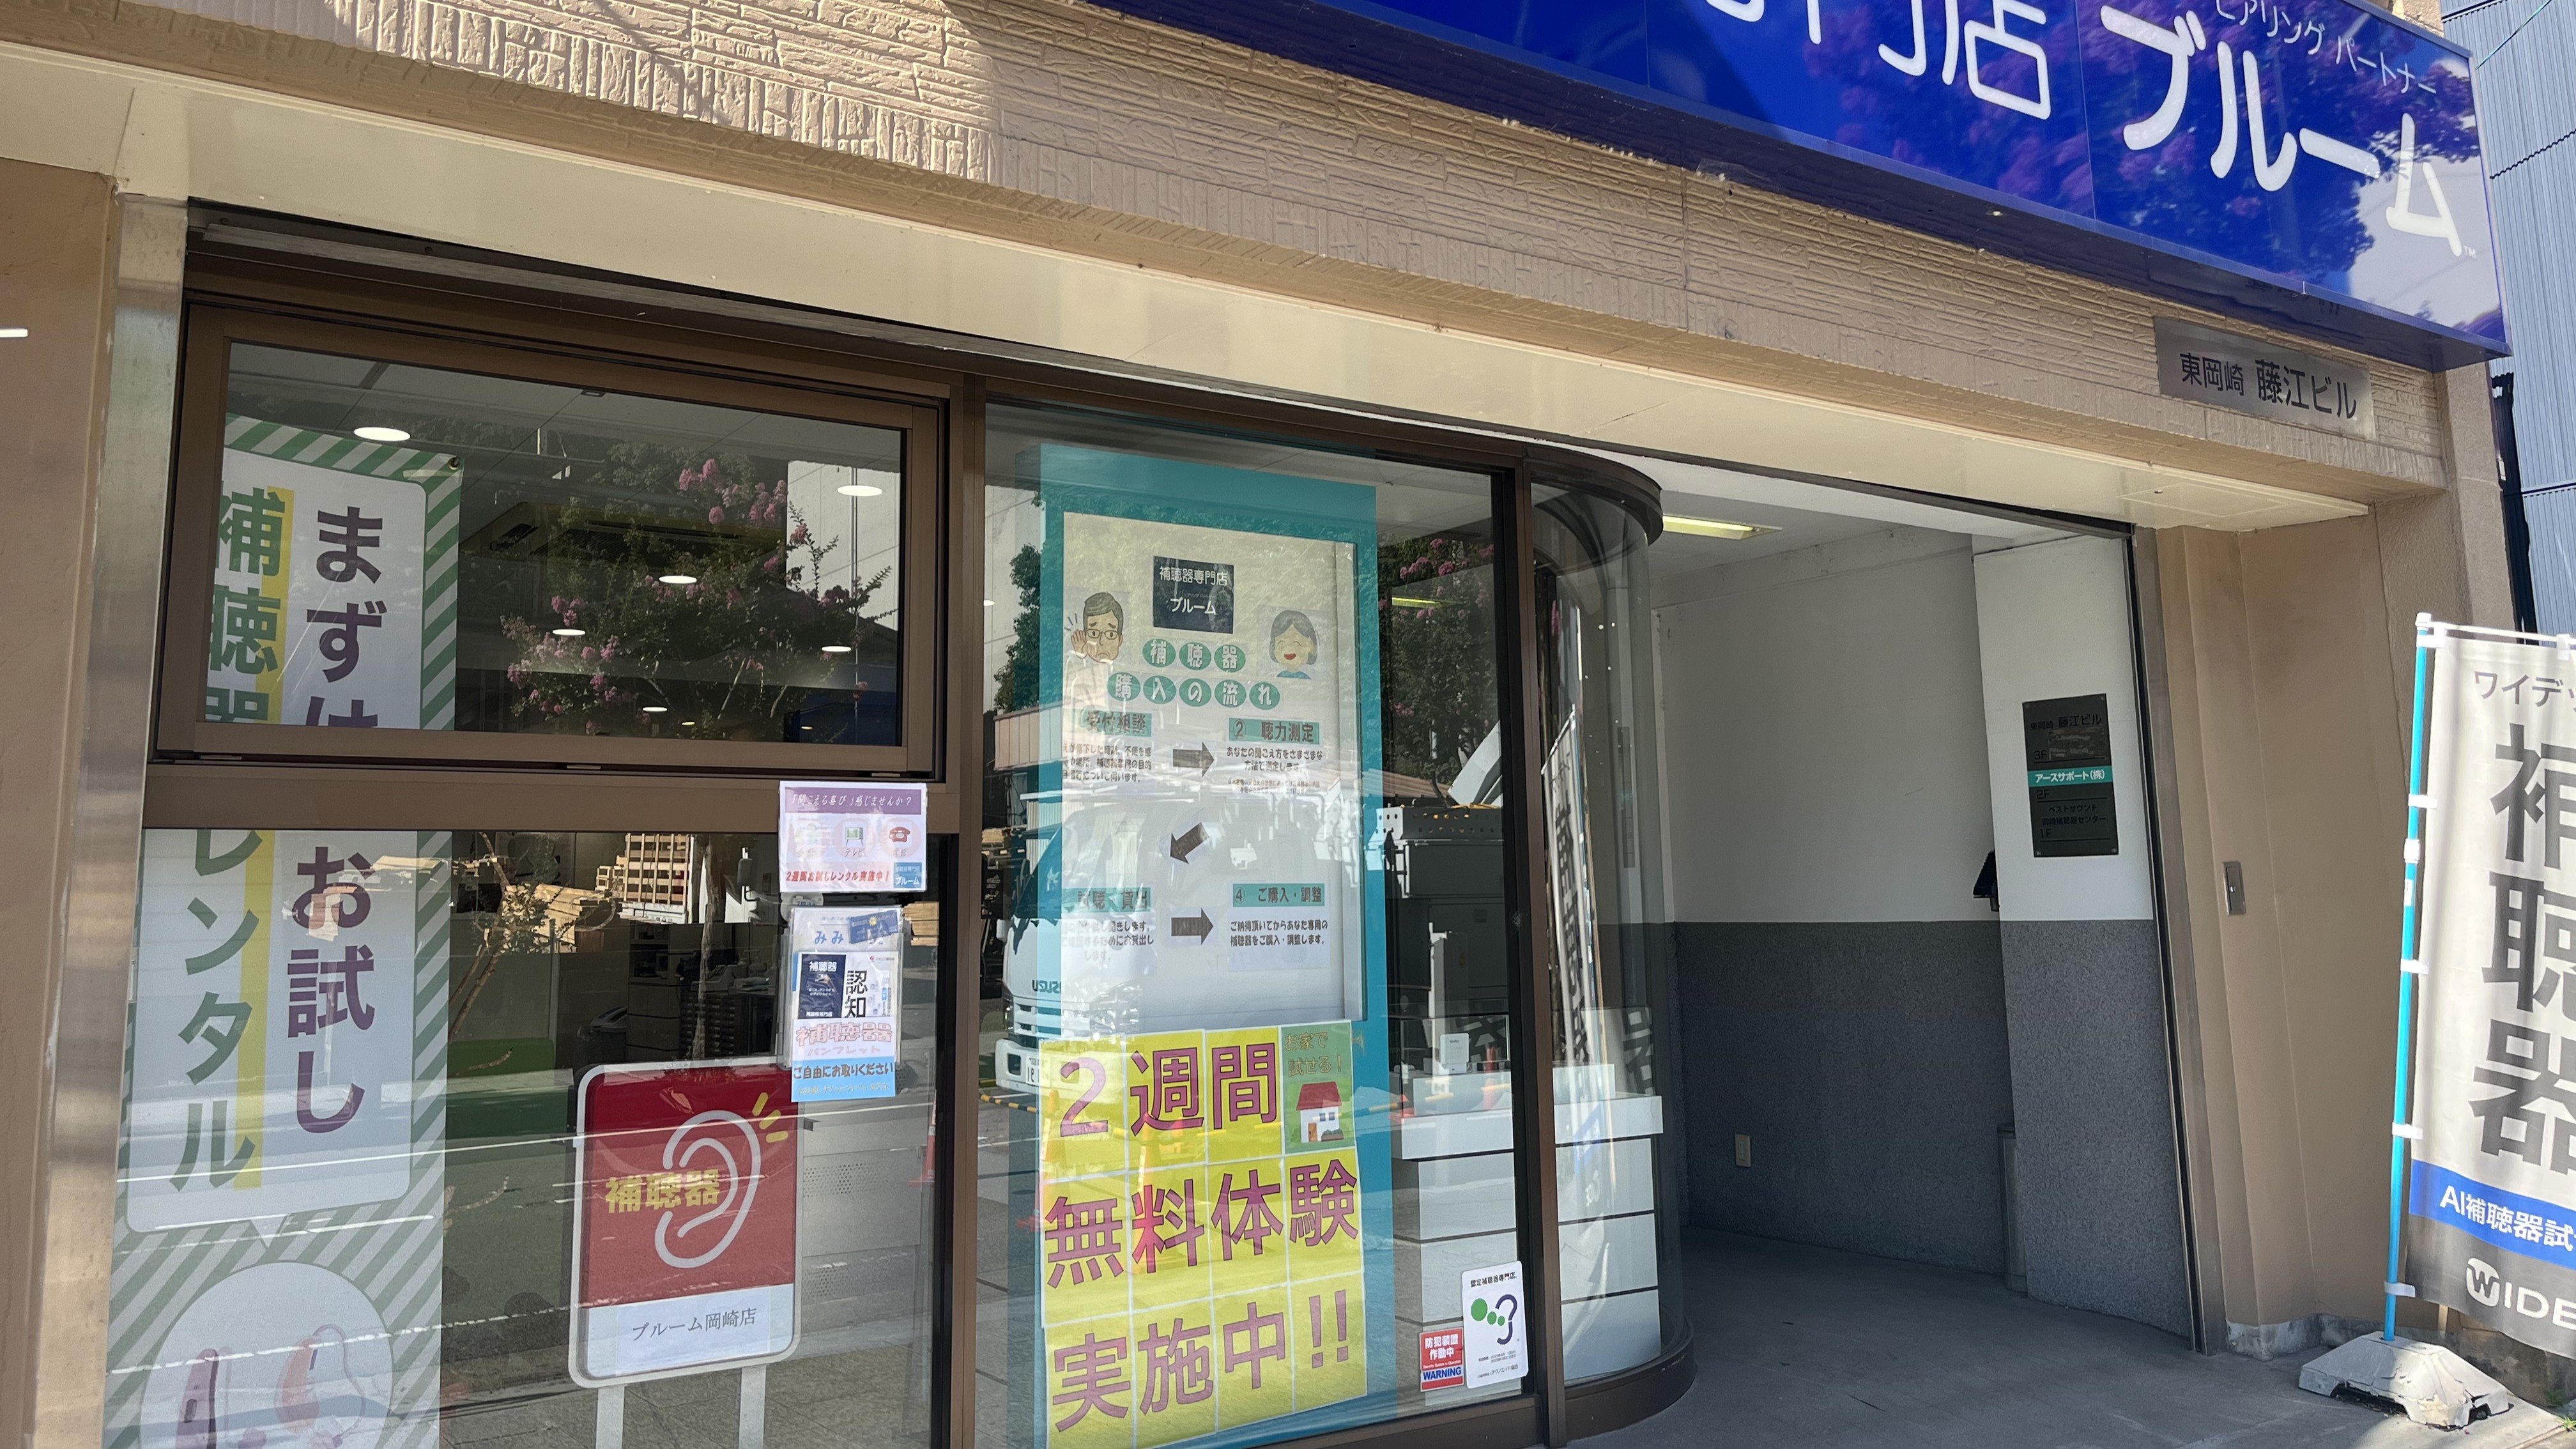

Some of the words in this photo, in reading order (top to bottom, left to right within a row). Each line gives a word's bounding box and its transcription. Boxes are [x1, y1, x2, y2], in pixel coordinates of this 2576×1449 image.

[2335, 36, 2437, 94] パートナー
[2100, 5, 2462, 256] ブルーム
[2179, 352, 2244, 396] 東岡崎
[2255, 359, 2358, 419] 藤江ビル
[1159, 566, 1228, 586] 補聴器専門店
[1170, 597, 1216, 615] ブルーム
[1149, 641, 1238, 668] 補聴器
[1115, 673, 1273, 707] 購入の流れ
[1261, 721, 1314, 742] 聴力測定
[1226, 746, 1323, 761] あなたの聞こえ方をさまざまな
[2035, 769, 2105, 783] アースサポート(株)
[895, 876, 919, 885] ブルーム
[1257, 886, 1322, 903] ご購入・調整
[1230, 919, 1328, 932] ご納得頂いてからあなた専用の
[1230, 934, 1325, 947] 補聴器をご購入・調整します。
[809, 961, 838, 972] 補聴器
[287, 846, 376, 1134] お試し
[796, 1022, 893, 1046] 補聴器
[1285, 1031, 1329, 1051] お家で
[793, 1062, 894, 1080] ご自由にお取りください
[1058, 1042, 1280, 1137] 2週間
[605, 1168, 721, 1214] 補聴器
[1045, 1159, 1359, 1289] 無料体験
[2439, 1185, 2576, 1252] AI補聴器試
[632, 1307, 757, 1342] ブルーム岡崎店
[1429, 1346, 1455, 1361] 作動中
[1423, 1366, 1462, 1381] WARNING
